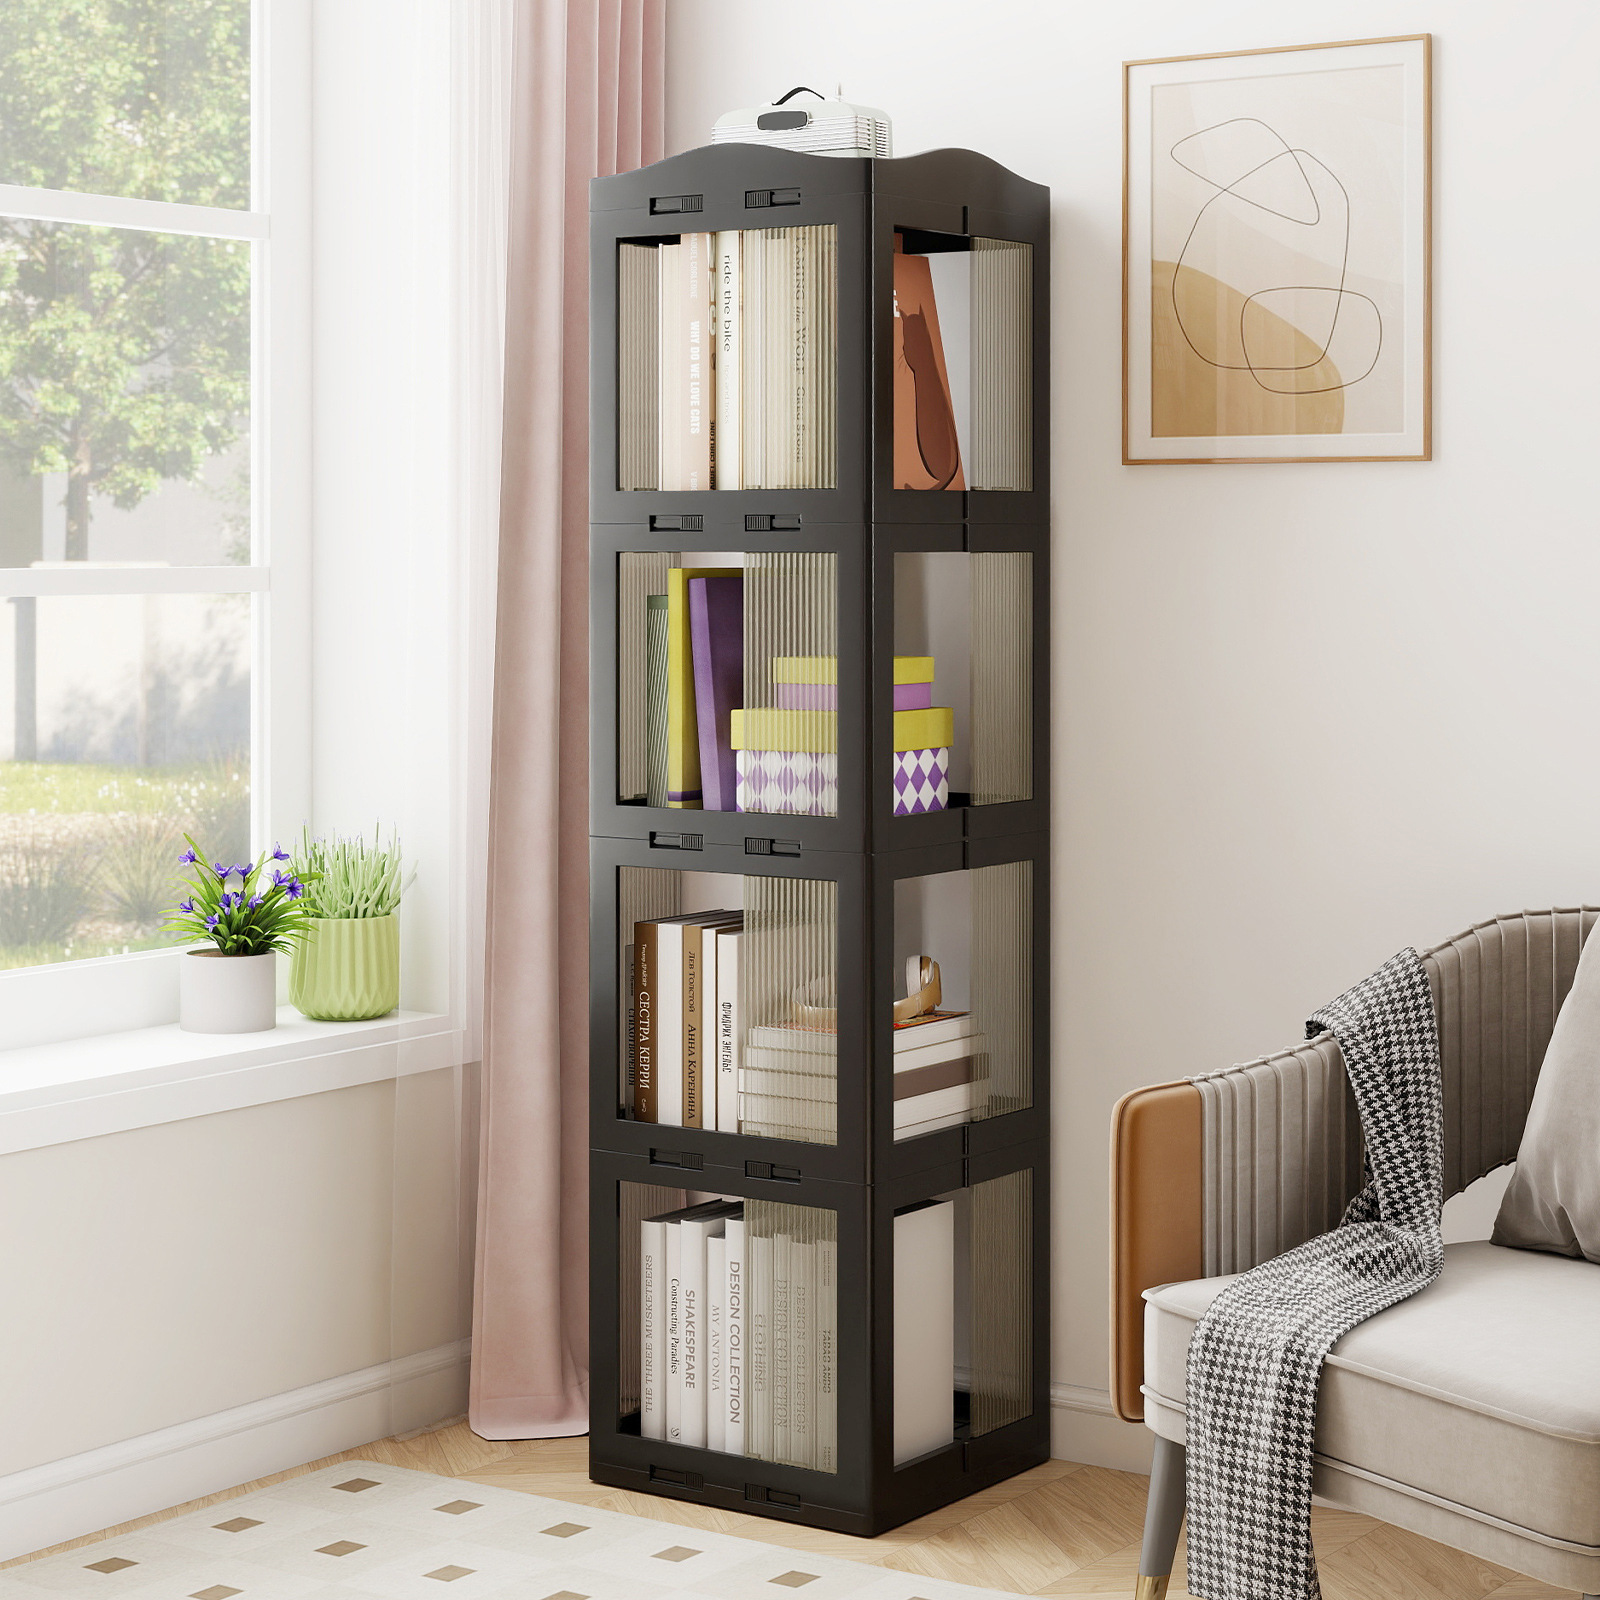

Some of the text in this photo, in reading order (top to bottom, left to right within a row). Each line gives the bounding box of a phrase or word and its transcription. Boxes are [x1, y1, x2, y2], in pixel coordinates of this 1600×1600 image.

[690, 262, 698, 298] CORLEONE
[723, 255, 732, 352] ride the bike
[690, 321, 700, 434] WHY DO WE LOVE CATS
[639, 991, 650, 1089] СЕСТРА КЕРРИ
[688, 1024, 696, 1119] АННА КАРЕНИНА
[721, 1002, 732, 1073] ФРИДРИХ ЭНГЕЛЬС
[645, 1255, 653, 1413] THE THREE MUSKETEERS
[669, 1278, 680, 1374] Constructing Paradies
[685, 1289, 695, 1389] SHAKESPEARE
[712, 1304, 720, 1391] MY ANTONIA
[729, 1261, 740, 1424] DESIGN COLLECTION
